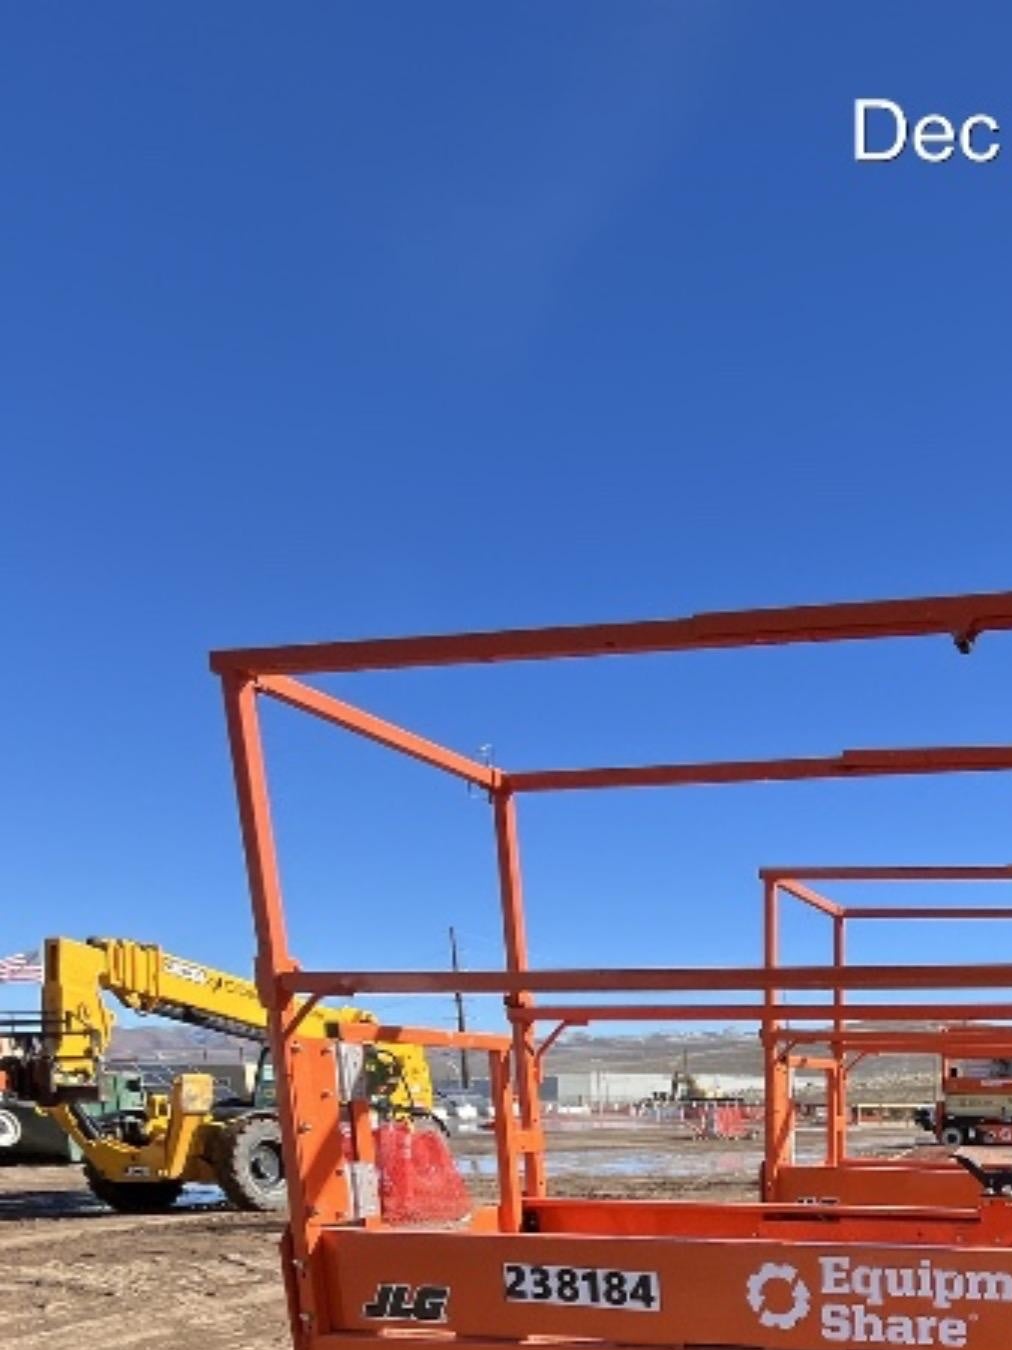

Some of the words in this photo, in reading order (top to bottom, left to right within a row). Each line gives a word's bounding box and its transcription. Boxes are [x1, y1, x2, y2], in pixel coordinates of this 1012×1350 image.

[363, 1283, 449, 1321] JLG
[504, 1264, 657, 1309] 238184
[820, 1305, 968, 1347] Share
